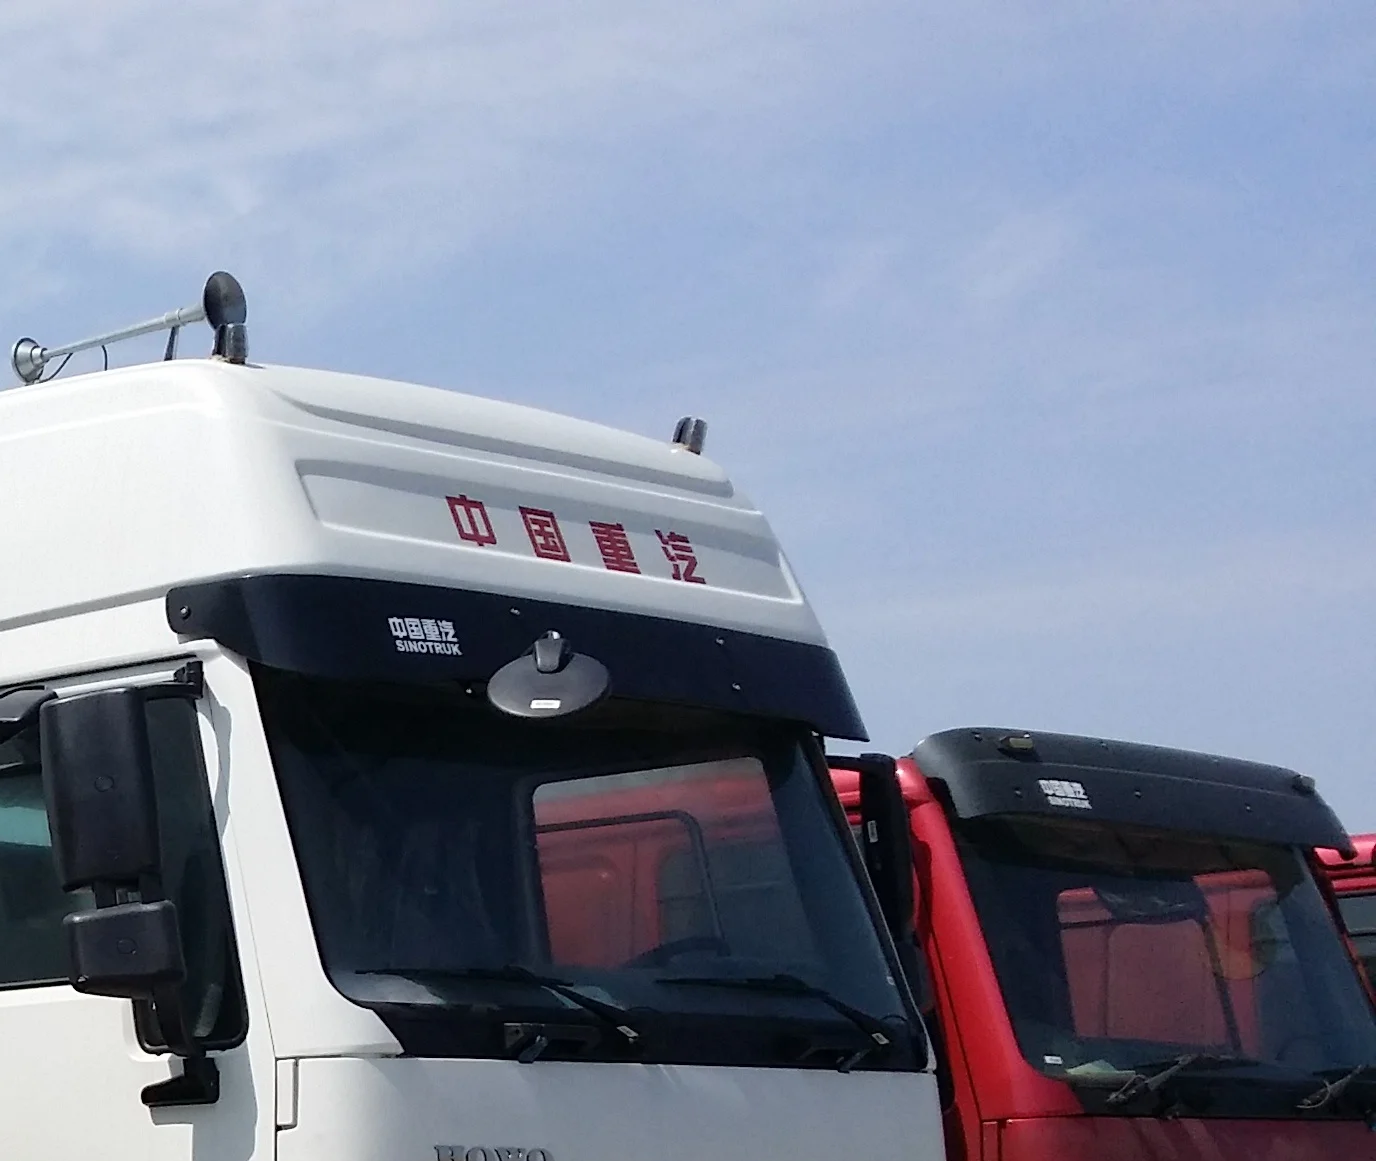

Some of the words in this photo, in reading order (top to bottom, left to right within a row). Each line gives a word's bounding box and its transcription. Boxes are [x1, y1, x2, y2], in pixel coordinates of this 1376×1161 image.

[445, 494, 706, 584] 中国重汽
[388, 617, 458, 642] 中国重汽
[395, 640, 463, 656] SINOTRUK
